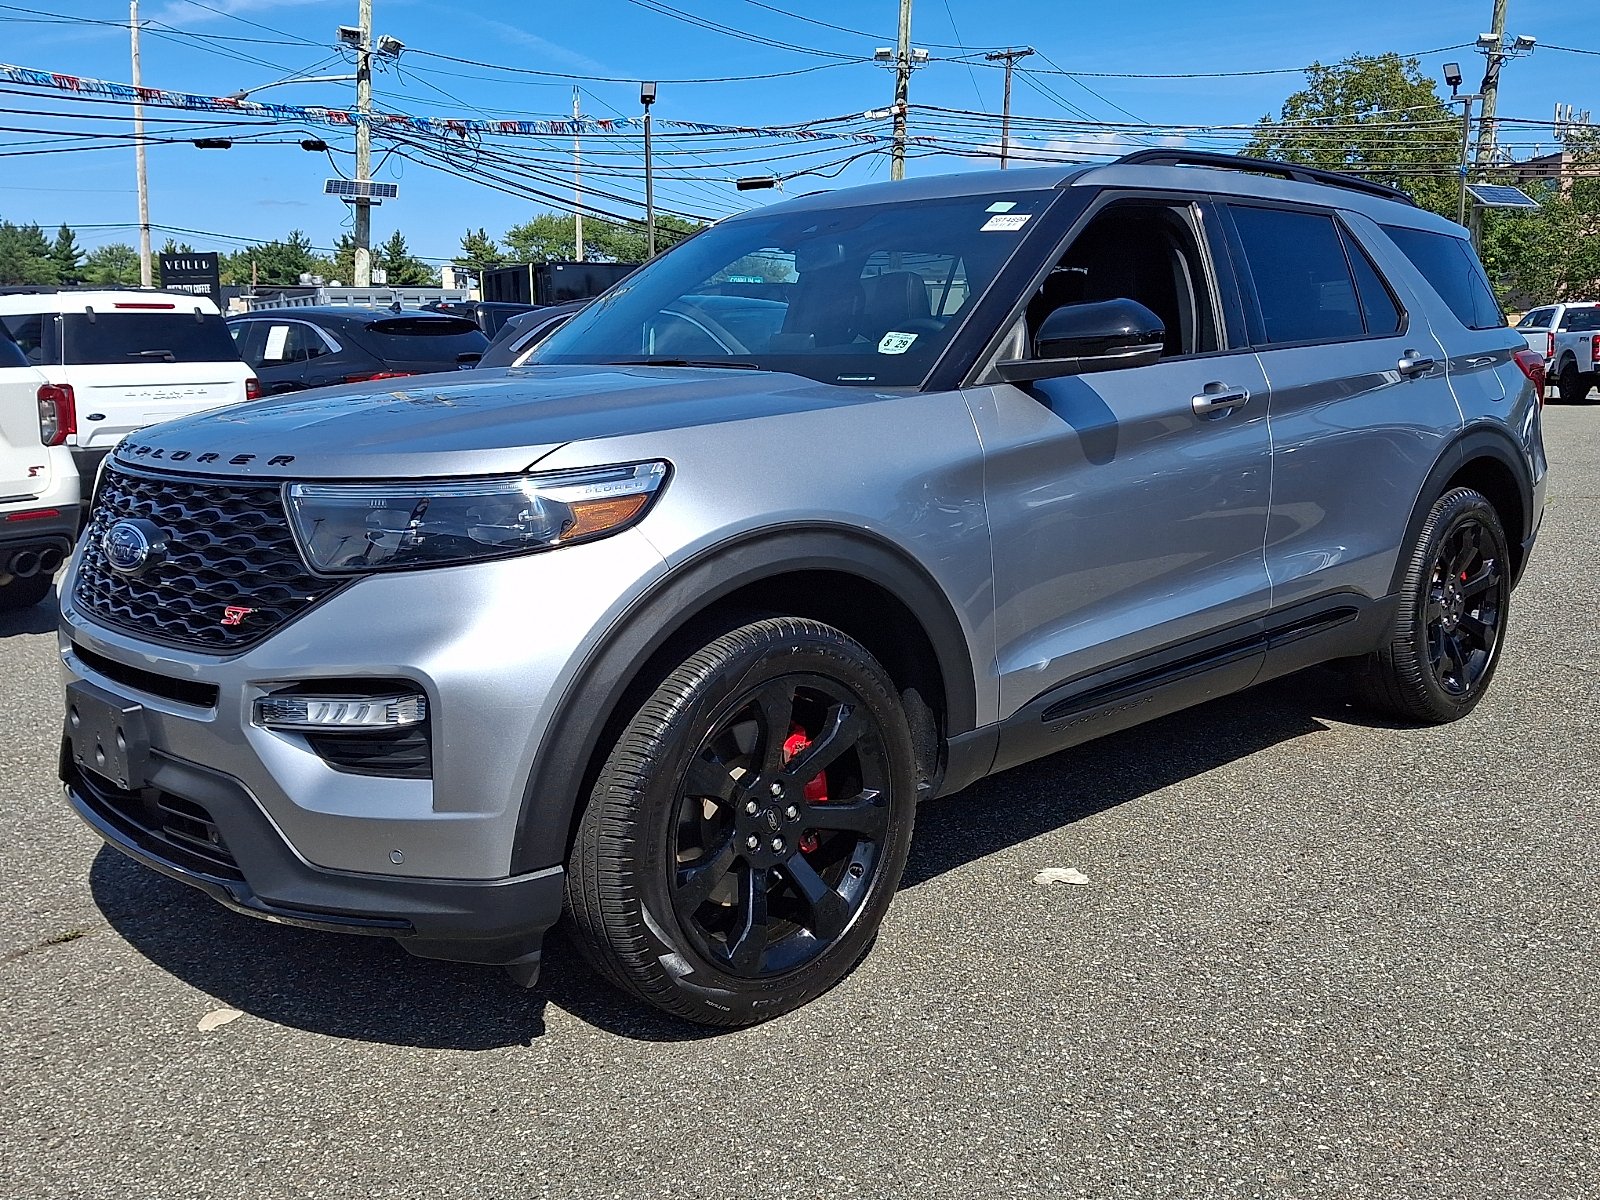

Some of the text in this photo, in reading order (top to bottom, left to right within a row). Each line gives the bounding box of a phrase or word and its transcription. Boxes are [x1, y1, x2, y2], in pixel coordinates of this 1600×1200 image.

[883, 338, 909, 349] 8 29
[221, 606, 252, 625] ST
